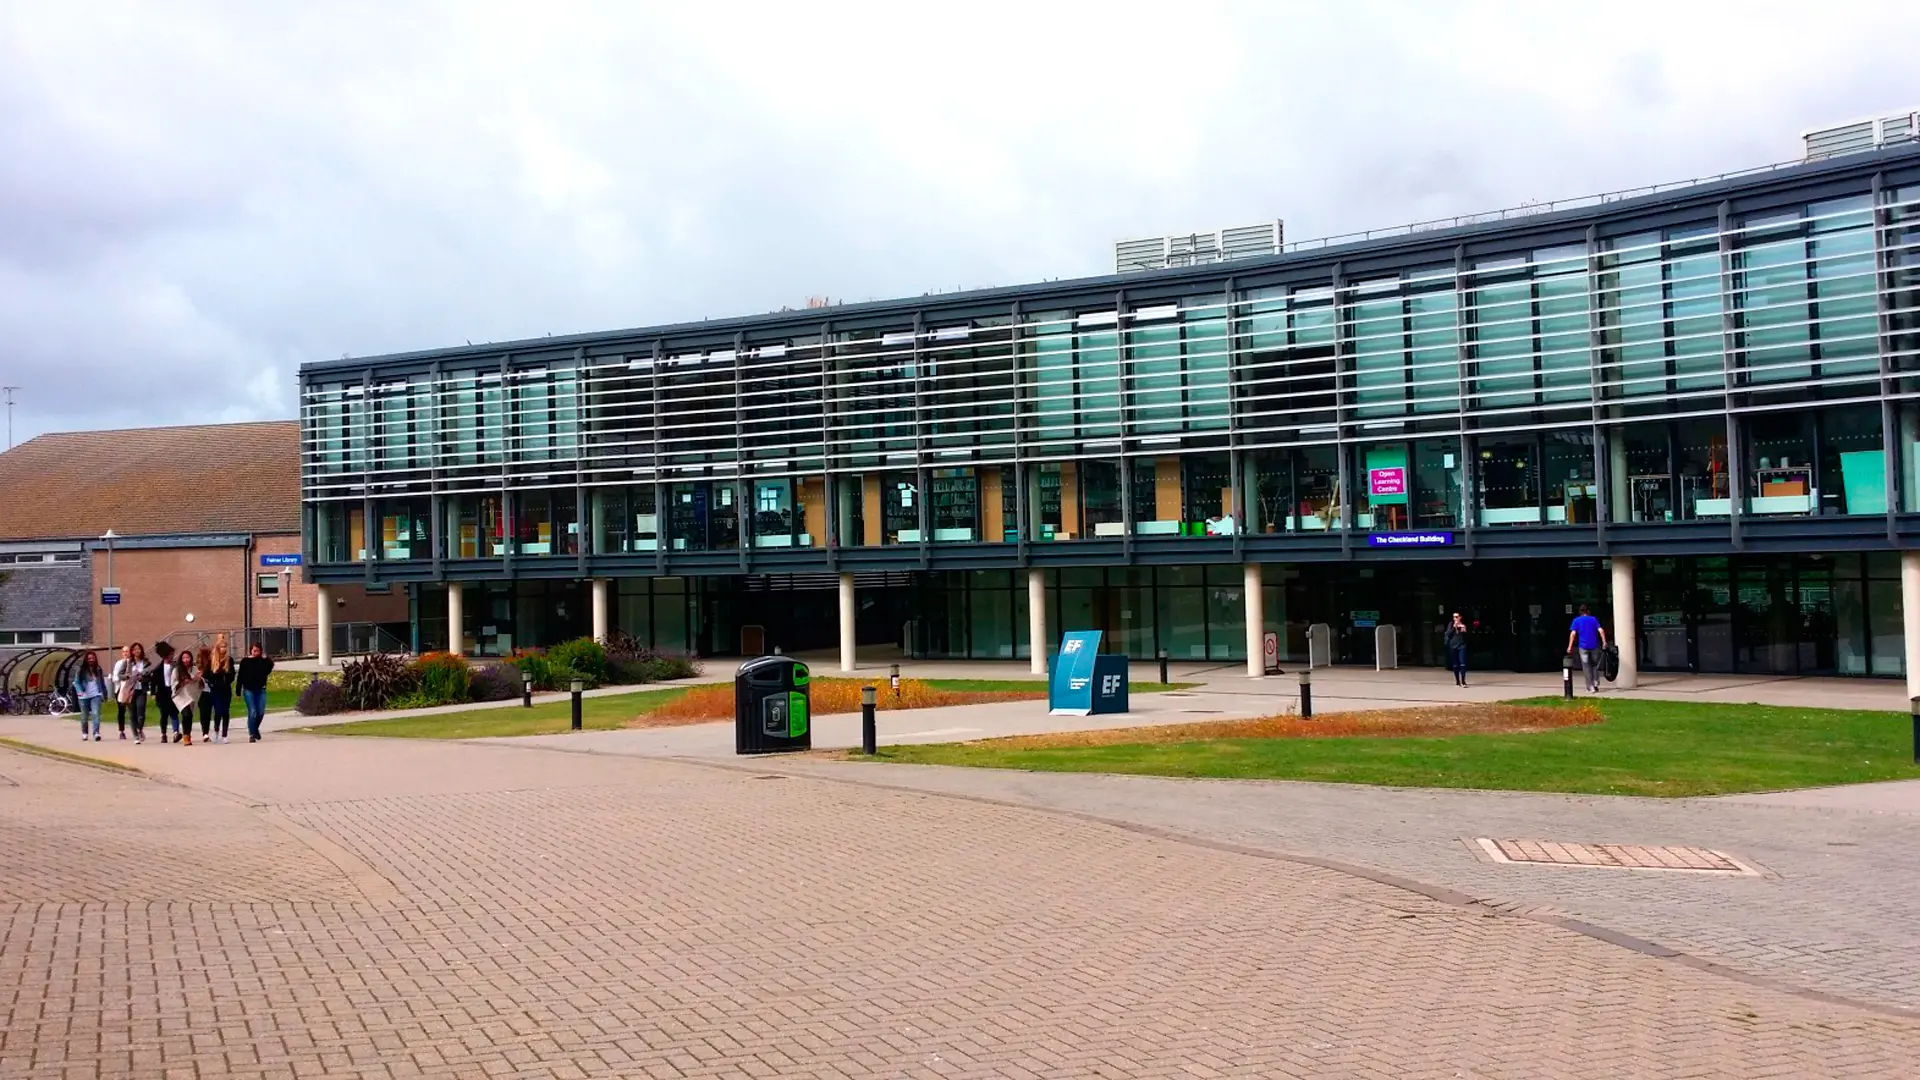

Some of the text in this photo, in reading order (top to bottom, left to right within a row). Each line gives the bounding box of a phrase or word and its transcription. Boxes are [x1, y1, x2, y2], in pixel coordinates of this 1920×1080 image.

[1388, 535, 1418, 543] Checkland
[1419, 535, 1445, 543] Building
[1064, 639, 1084, 653] EF
[1101, 674, 1121, 694] EF
